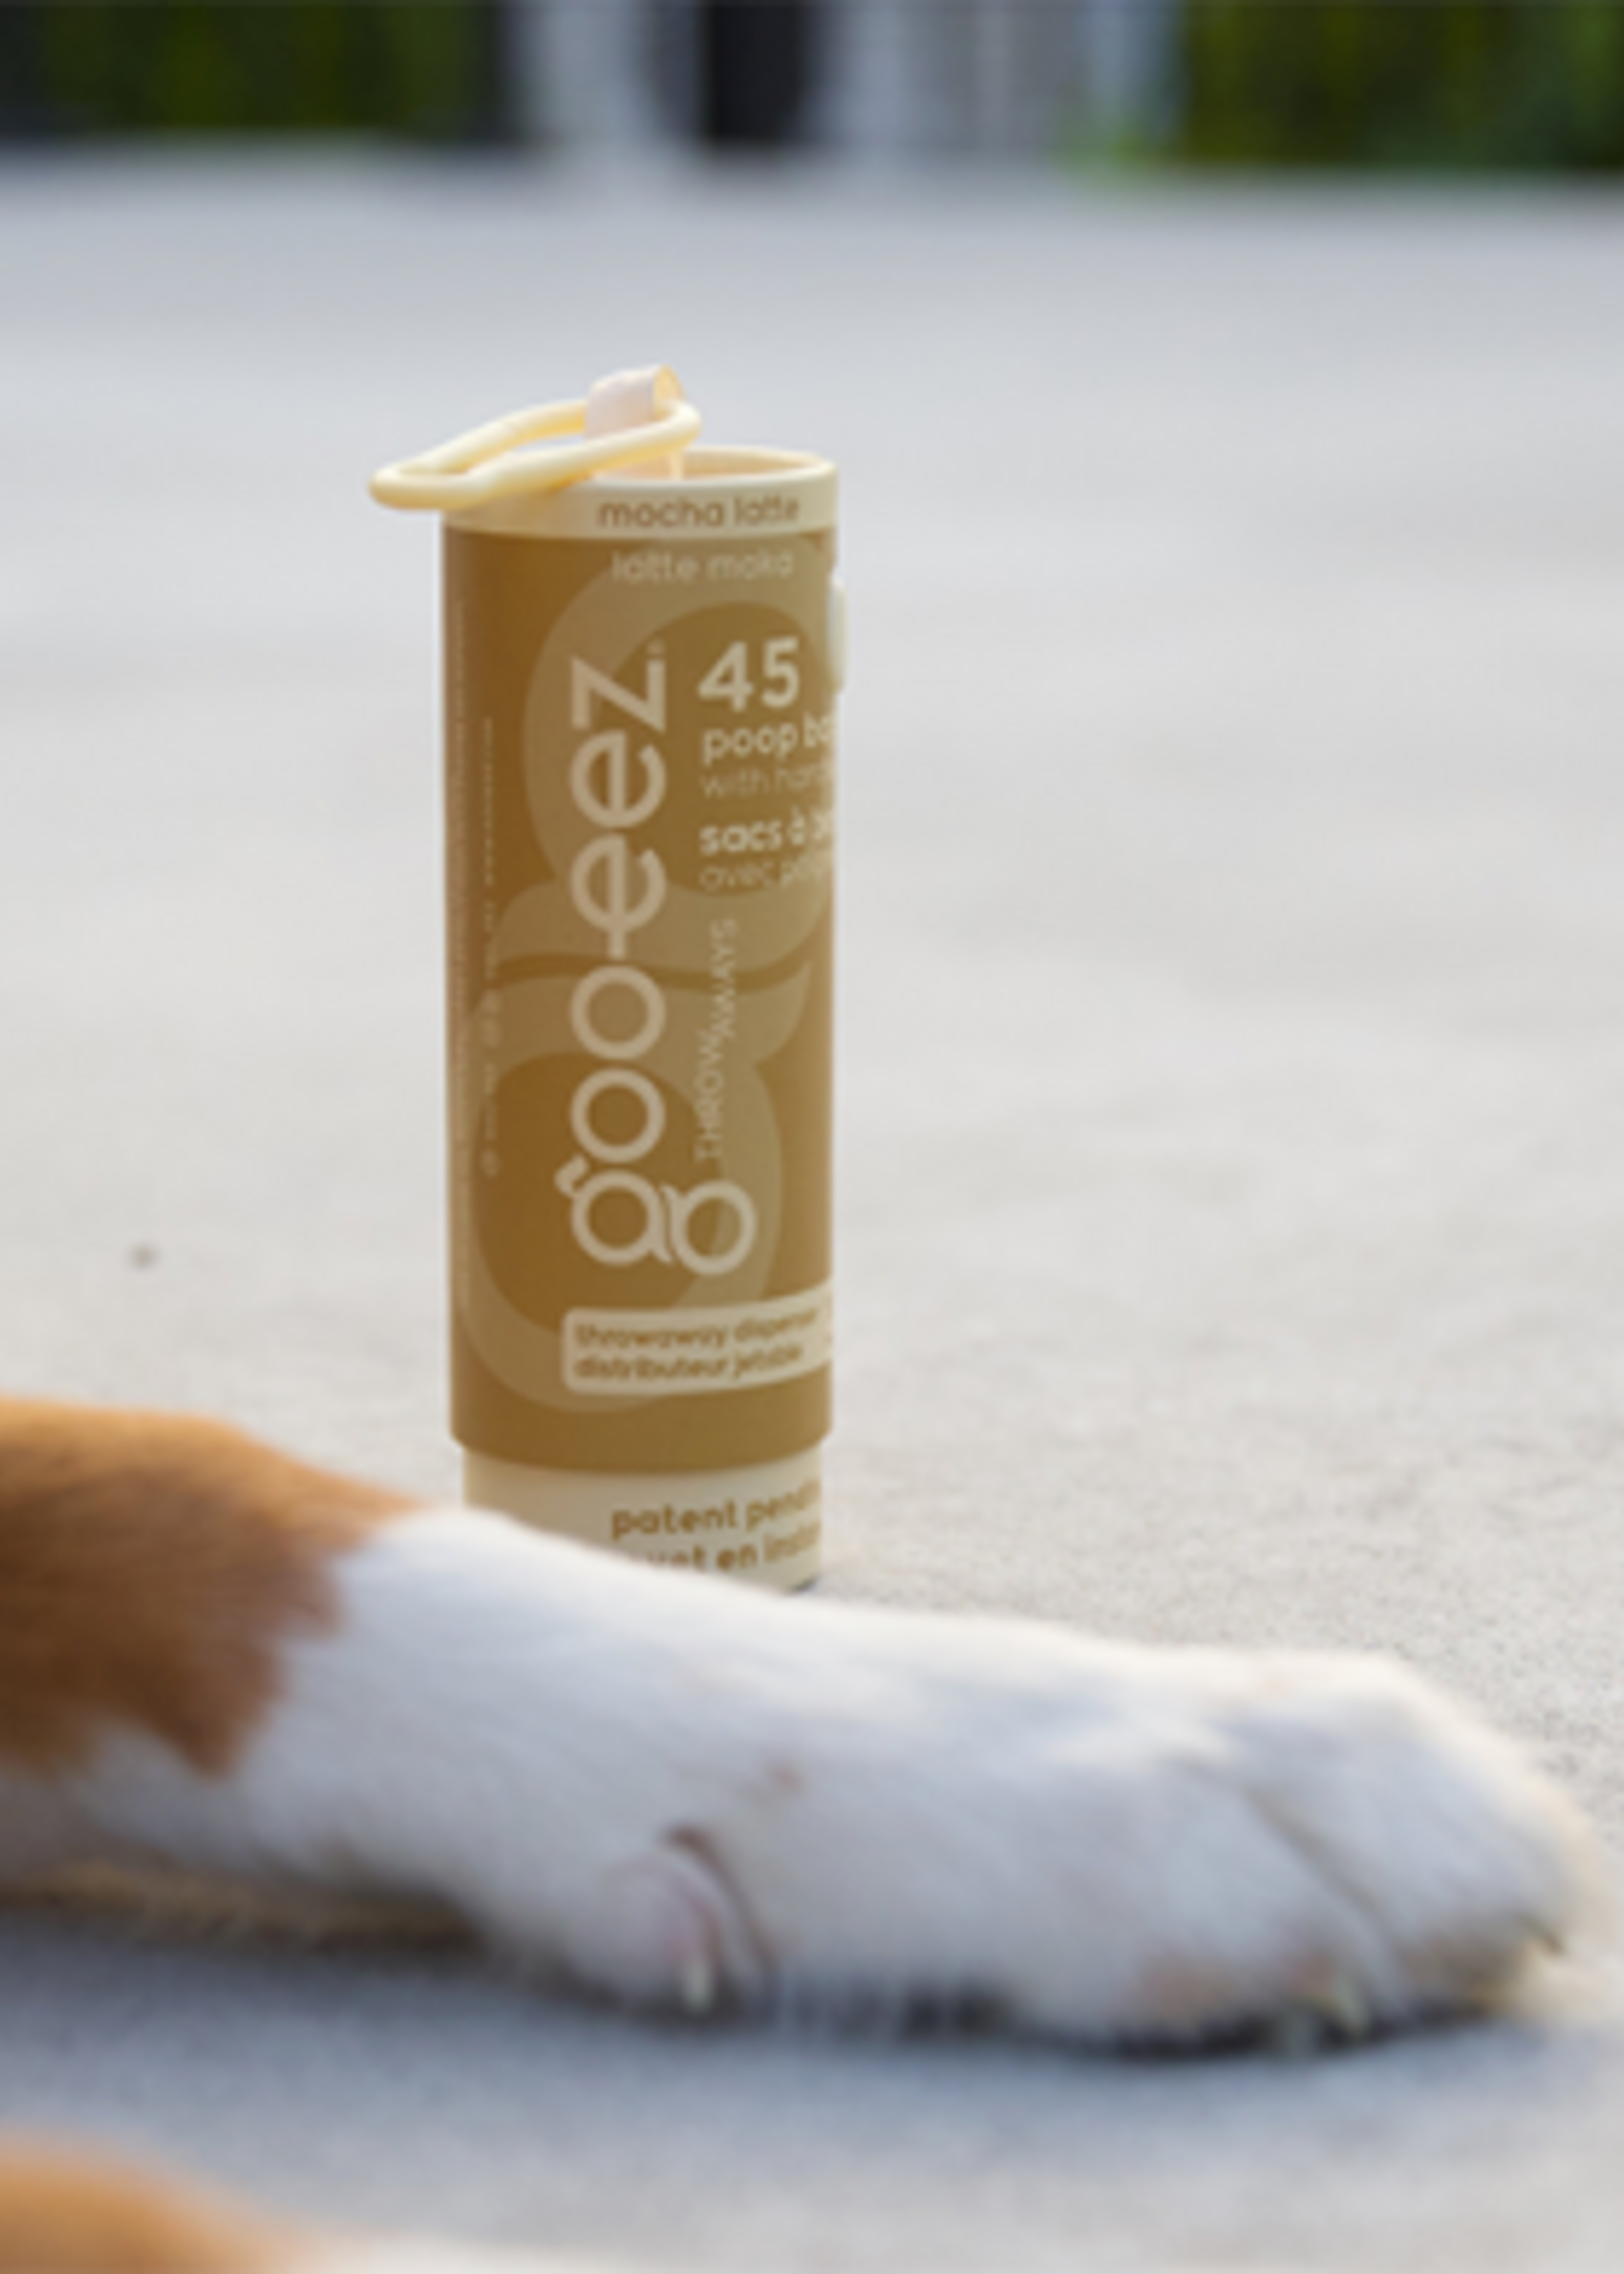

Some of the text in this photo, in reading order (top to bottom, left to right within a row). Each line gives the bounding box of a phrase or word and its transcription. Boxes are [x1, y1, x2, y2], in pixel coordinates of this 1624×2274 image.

[598, 494, 801, 528] mocha latte
[610, 551, 701, 583] latte
[696, 636, 800, 713] 45
[701, 722, 798, 768] poop
[697, 819, 783, 857] sacs
[610, 1498, 739, 1543] patent
[715, 1544, 759, 1572] en
